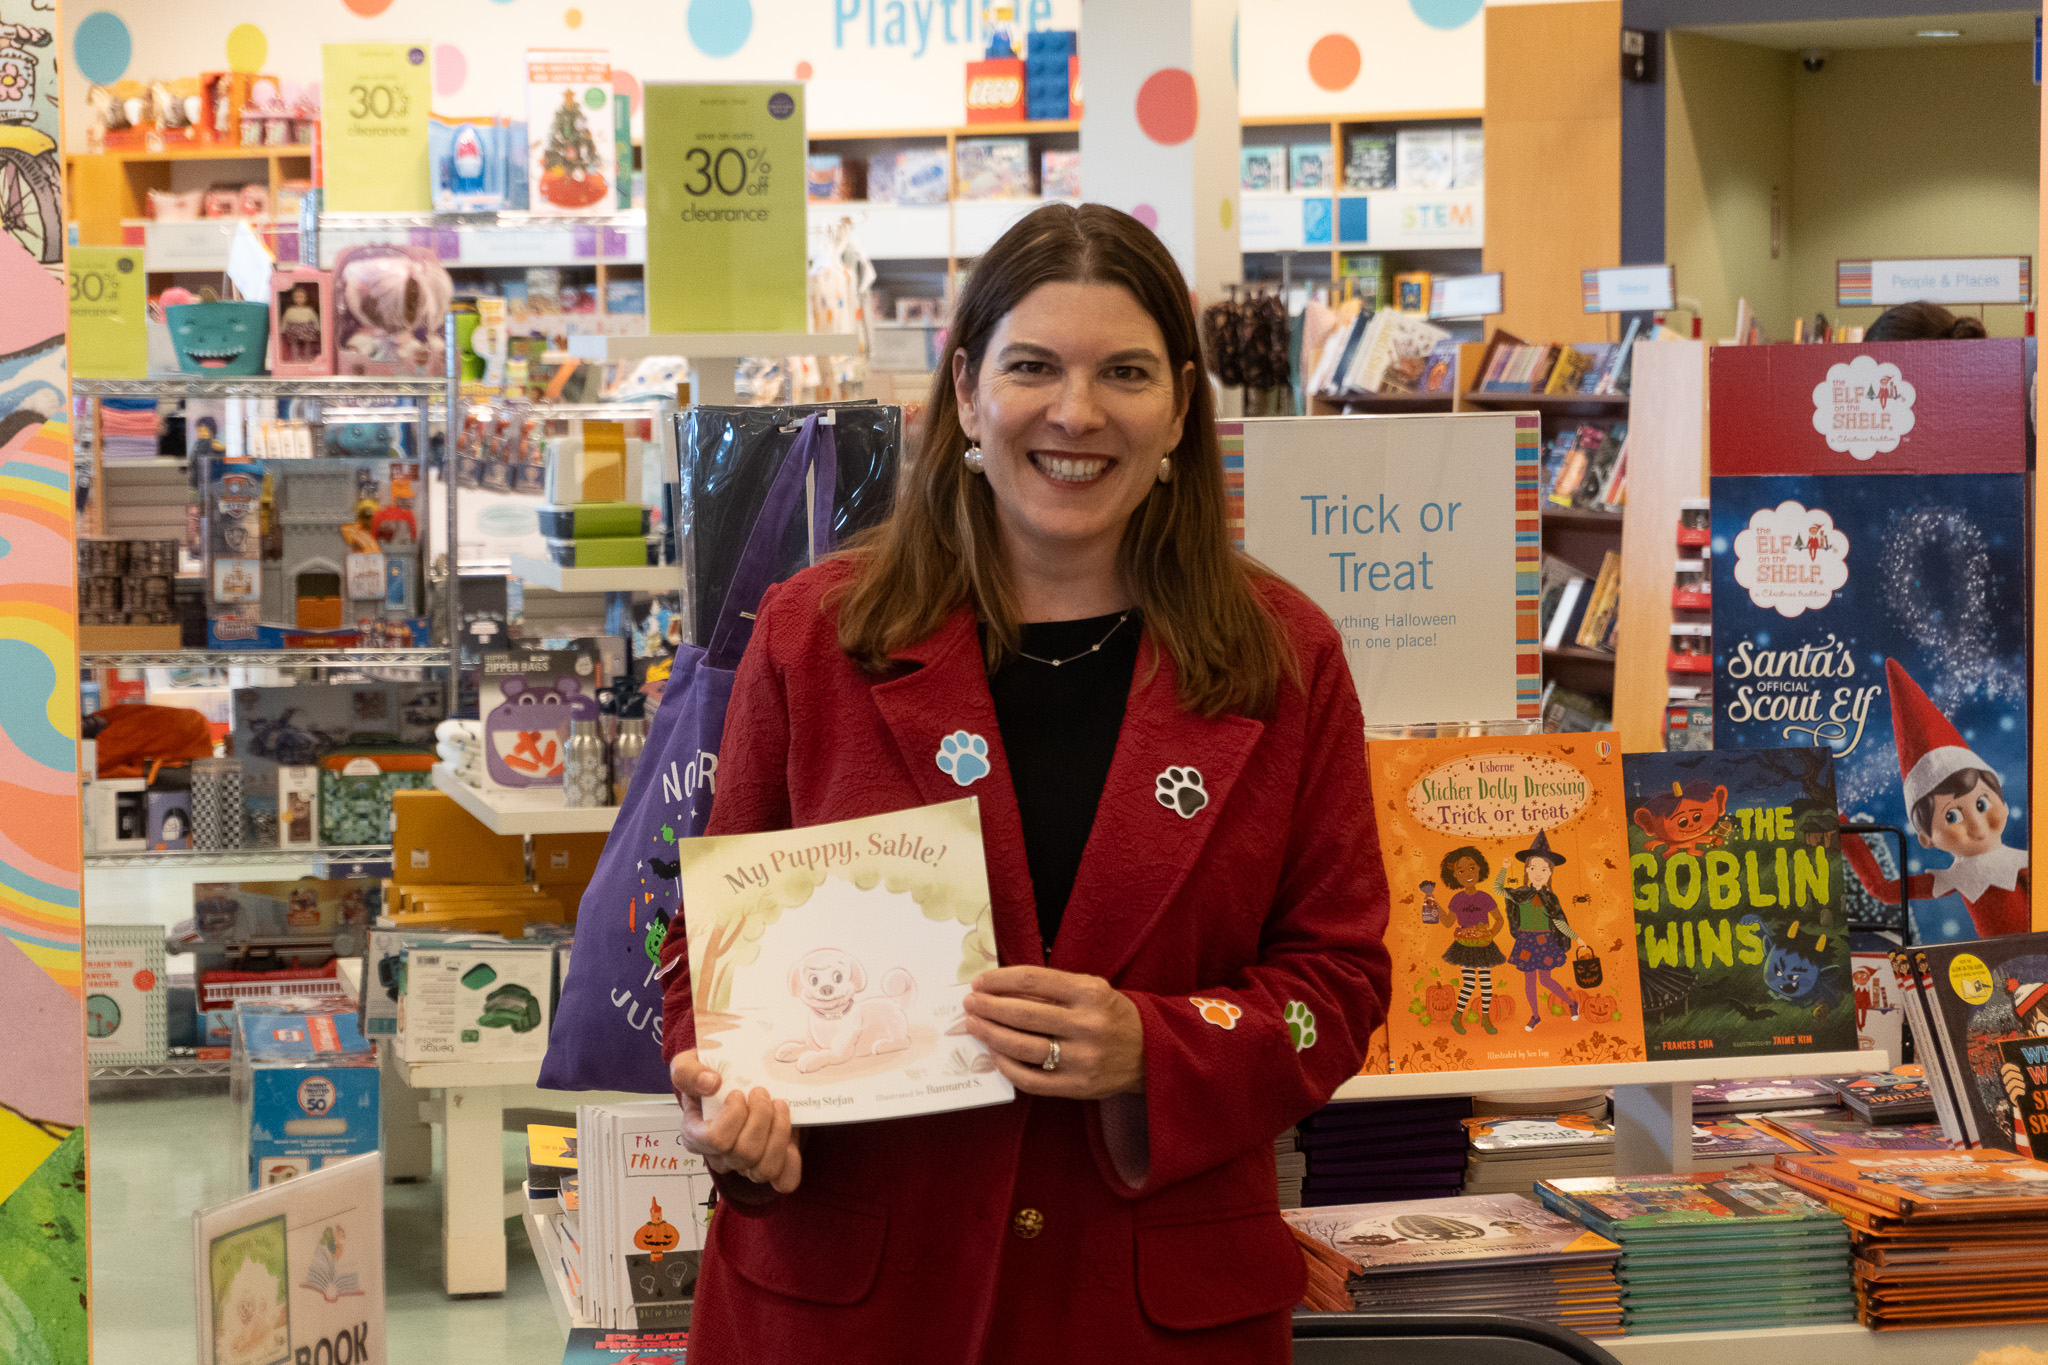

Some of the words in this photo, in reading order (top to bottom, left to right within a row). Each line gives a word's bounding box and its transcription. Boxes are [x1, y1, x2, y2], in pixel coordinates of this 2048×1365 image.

[684, 147, 772, 197] 30%
[746, 175, 769, 196] off
[681, 202, 769, 222] clearance
[1891, 274, 1937, 289] People
[1941, 274, 1951, 288] &
[1956, 273, 2000, 288] Places
[1832, 379, 1846, 387] the
[1833, 386, 1865, 403] ELF
[1847, 404, 1860, 412] the
[1301, 494, 1401, 536] Trick
[1419, 501, 1461, 533] or
[1756, 527, 1771, 535] the
[1756, 535, 1792, 554] ELF
[1772, 555, 1787, 563] the
[1329, 551, 1434, 592] Treat
[1761, 589, 1796, 598] Christmas
[1797, 589, 1828, 598] tradition
[1385, 613, 1457, 627] Halloween
[1347, 635, 1360, 648] in
[1365, 637, 1391, 648] one
[1396, 632, 1437, 650] place!
[1728, 634, 1856, 679] Santa's
[484, 663, 519, 673] ZIPPER
[520, 662, 549, 672] BAGS
[1756, 681, 1809, 693] OFFICIAL
[1727, 684, 1823, 723] Scout
[1479, 760, 1515, 774] Usborne
[1422, 776, 1473, 805] Sticker
[1478, 776, 1518, 805] Dolly
[1524, 775, 1585, 801] Dressing
[1437, 805, 1488, 825] Trick
[1493, 808, 1515, 822] or
[1522, 803, 1570, 821] treat
[1735, 806, 1795, 842] THE
[723, 863, 770, 895] My
[769, 839, 860, 874] Puppy,
[867, 832, 948, 868] Sable!
[1630, 846, 1830, 912] GOBLIN
[1635, 918, 1764, 969] WINS
[1662, 1040, 1696, 1050] FRANCES
[1698, 1039, 1714, 1049] CHA
[1773, 1036, 1796, 1046] JAIME
[1798, 1035, 1813, 1044] KIM
[1487, 1050, 1517, 1060] Illustrated
[307, 1098, 327, 1111] 50
[823, 1095, 855, 1107] Stefan
[635, 1134, 659, 1148] The
[630, 1153, 678, 1170] TRICK
[683, 1158, 697, 1167] or
[294, 1320, 368, 1365] BOOK
